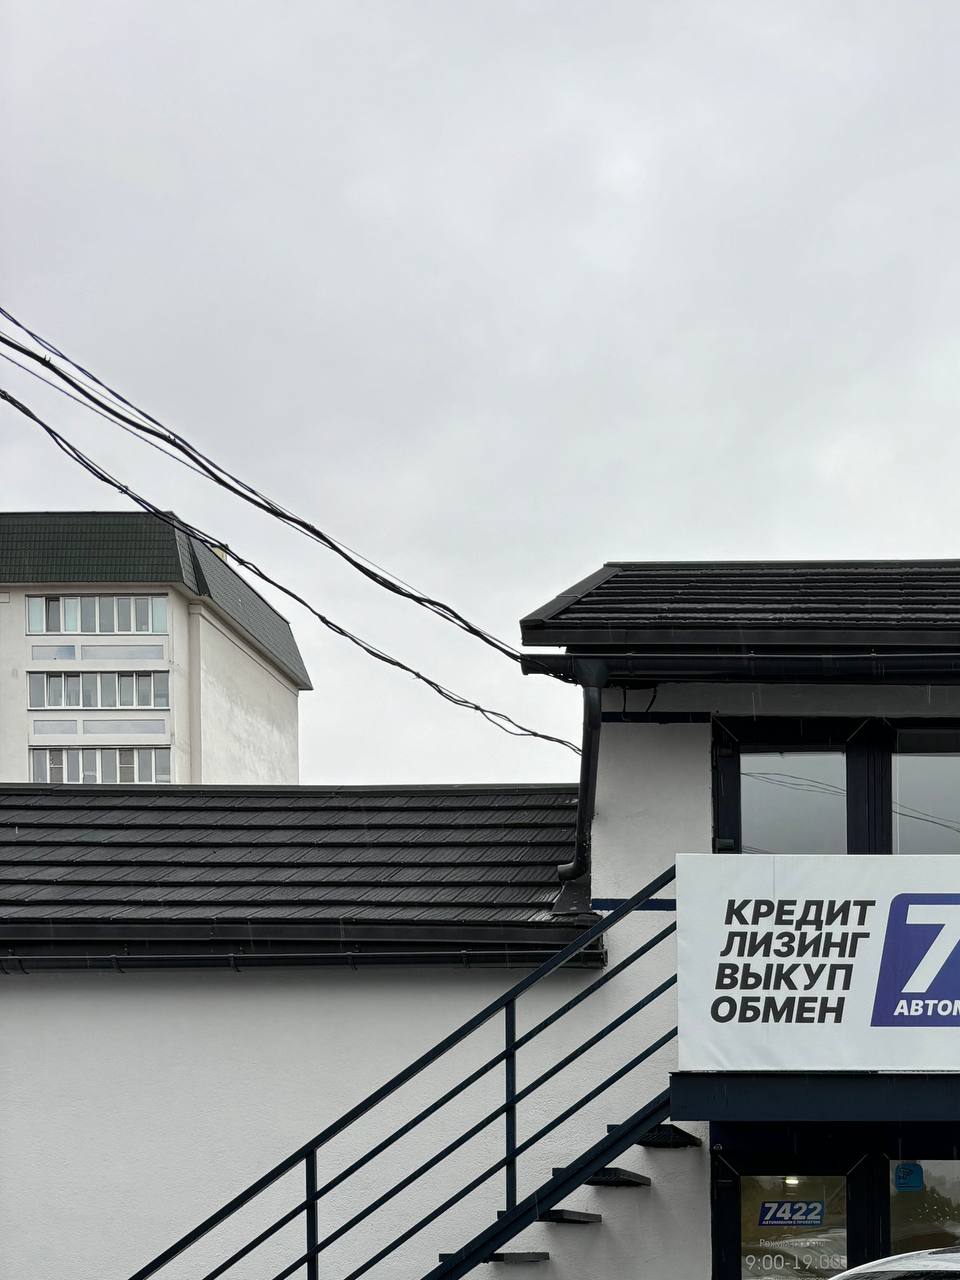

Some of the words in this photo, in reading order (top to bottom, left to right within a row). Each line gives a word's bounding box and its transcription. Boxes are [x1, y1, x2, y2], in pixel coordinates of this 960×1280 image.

[724, 899, 876, 931] КРЕДИТ
[720, 931, 870, 958] ЛИЗИНГ
[715, 963, 853, 991] ВЫКУП
[711, 996, 845, 1023] ОБМЕН
[764, 1202, 822, 1220] 7422
